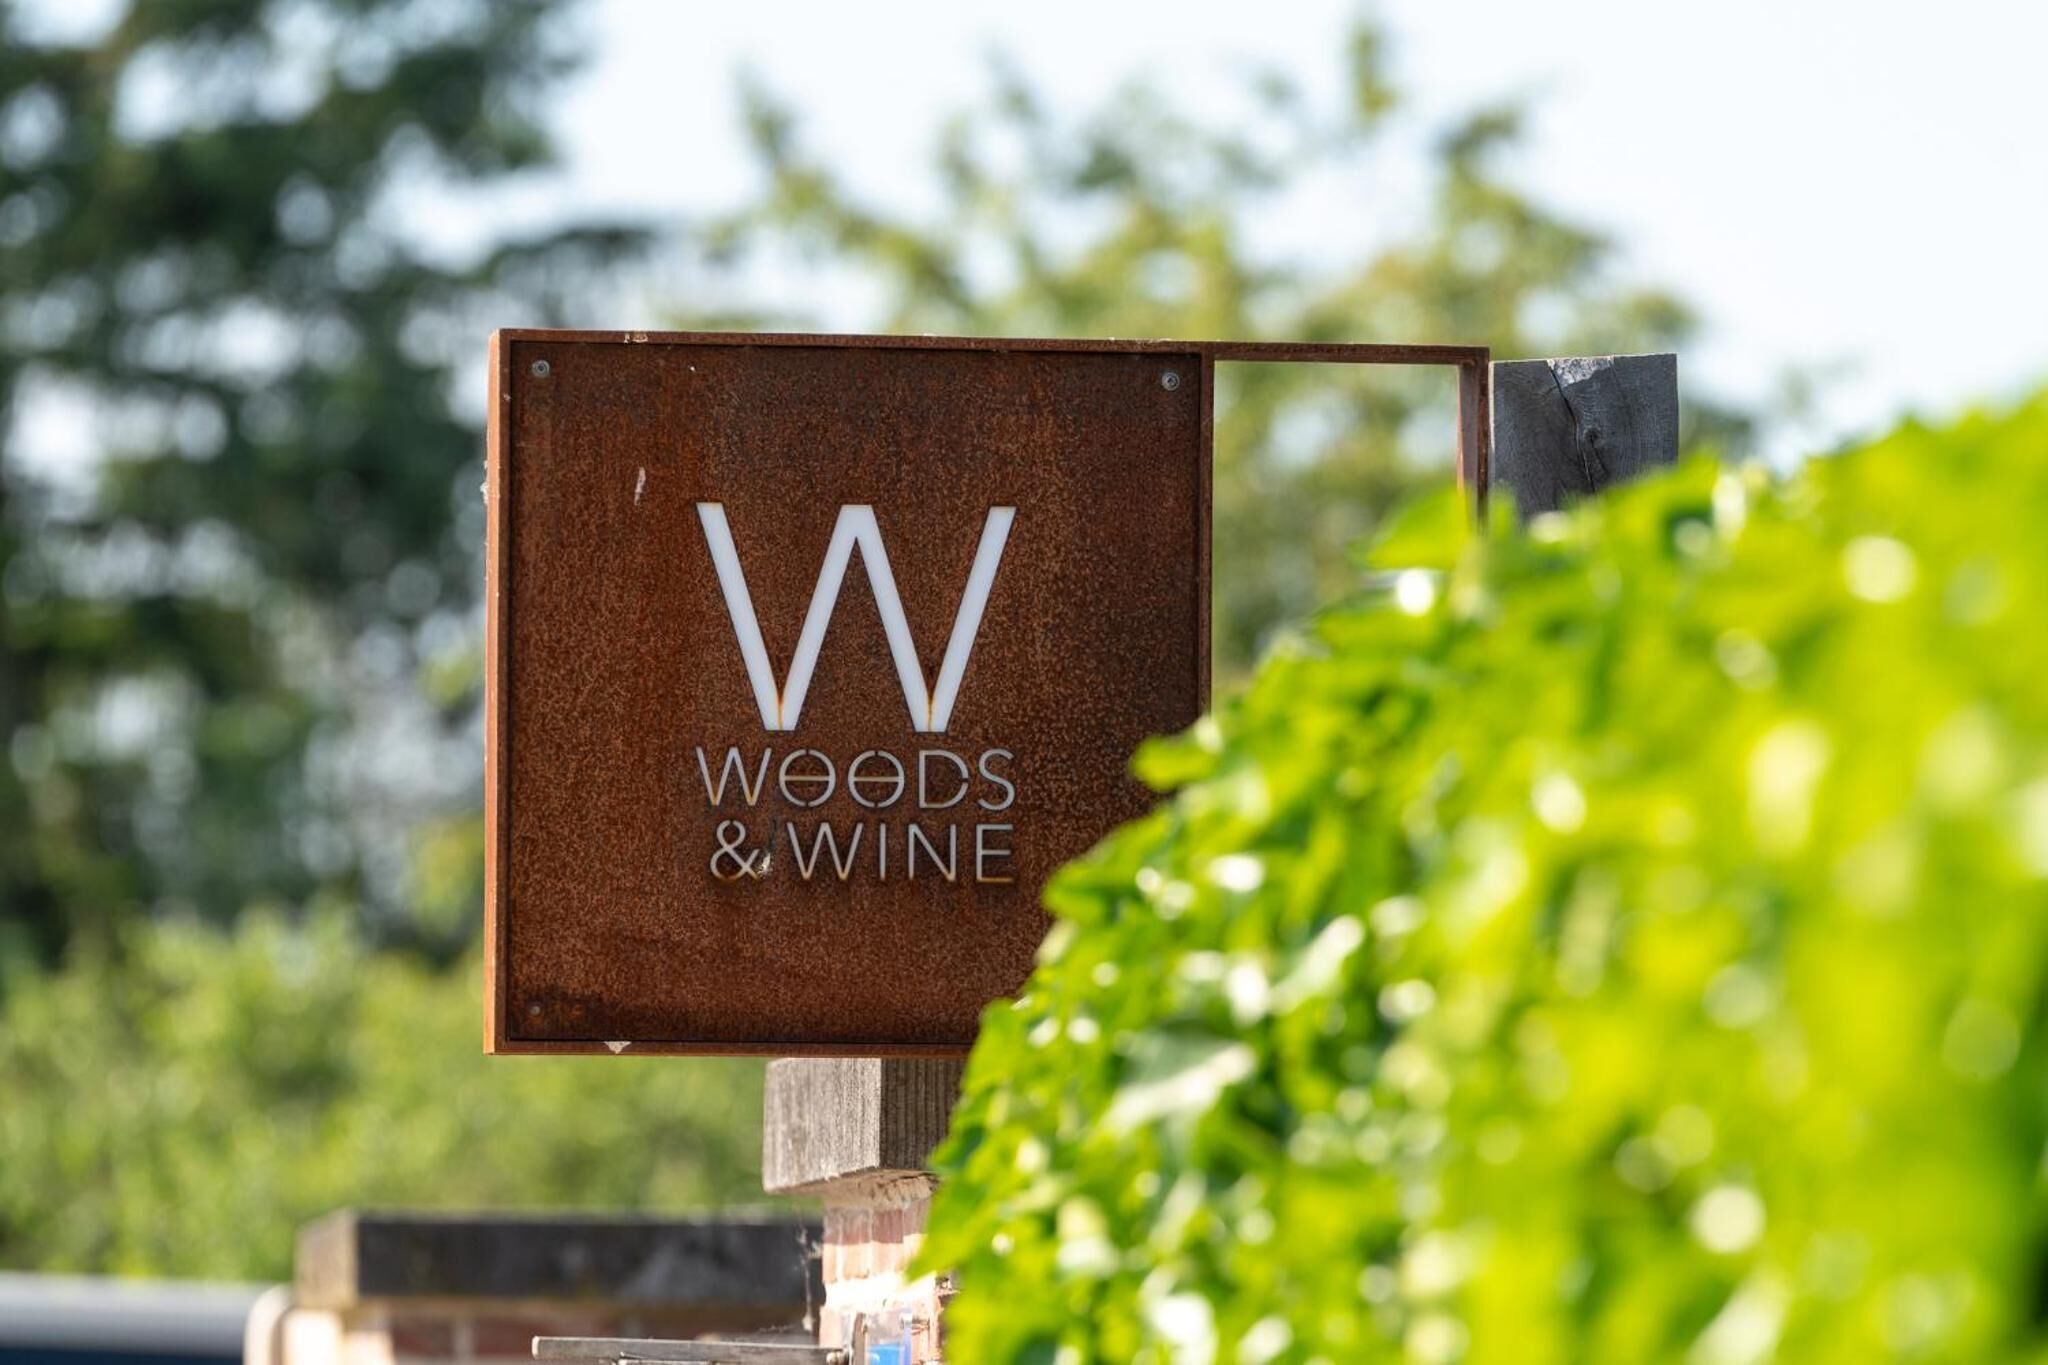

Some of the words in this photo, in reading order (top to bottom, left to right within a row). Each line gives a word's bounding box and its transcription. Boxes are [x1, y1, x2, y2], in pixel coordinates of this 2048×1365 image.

[696, 502, 1017, 732] W
[695, 746, 1016, 811] WOODS
[708, 819, 762, 882] &
[786, 821, 1014, 883] WINE
